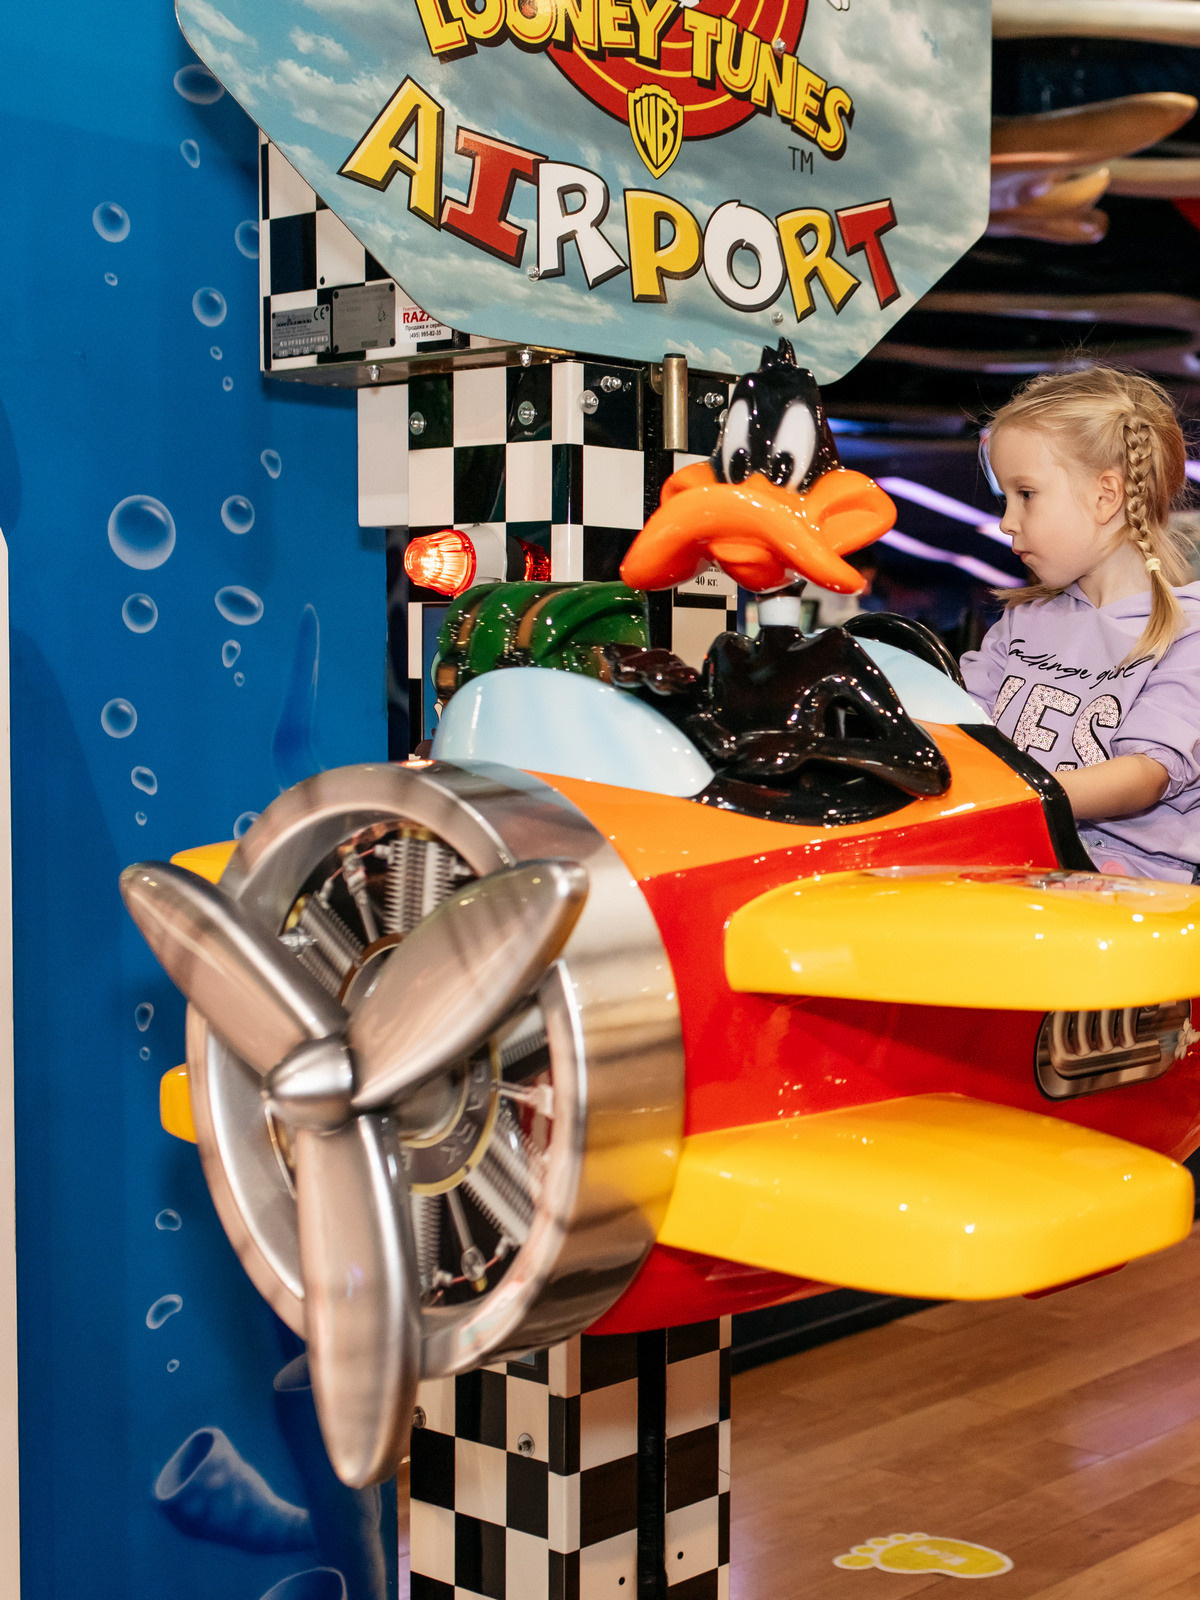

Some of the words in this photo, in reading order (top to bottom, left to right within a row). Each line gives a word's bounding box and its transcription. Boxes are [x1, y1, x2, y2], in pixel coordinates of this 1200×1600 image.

[416, 0, 680, 68] LOONEY
[683, 8, 854, 160] TUNES
[635, 94, 676, 168] WB
[788, 146, 814, 176] TM
[337, 74, 900, 321] AIRPORT
[695, 575, 705, 586] 40
[1089, 653, 1156, 690] girl
